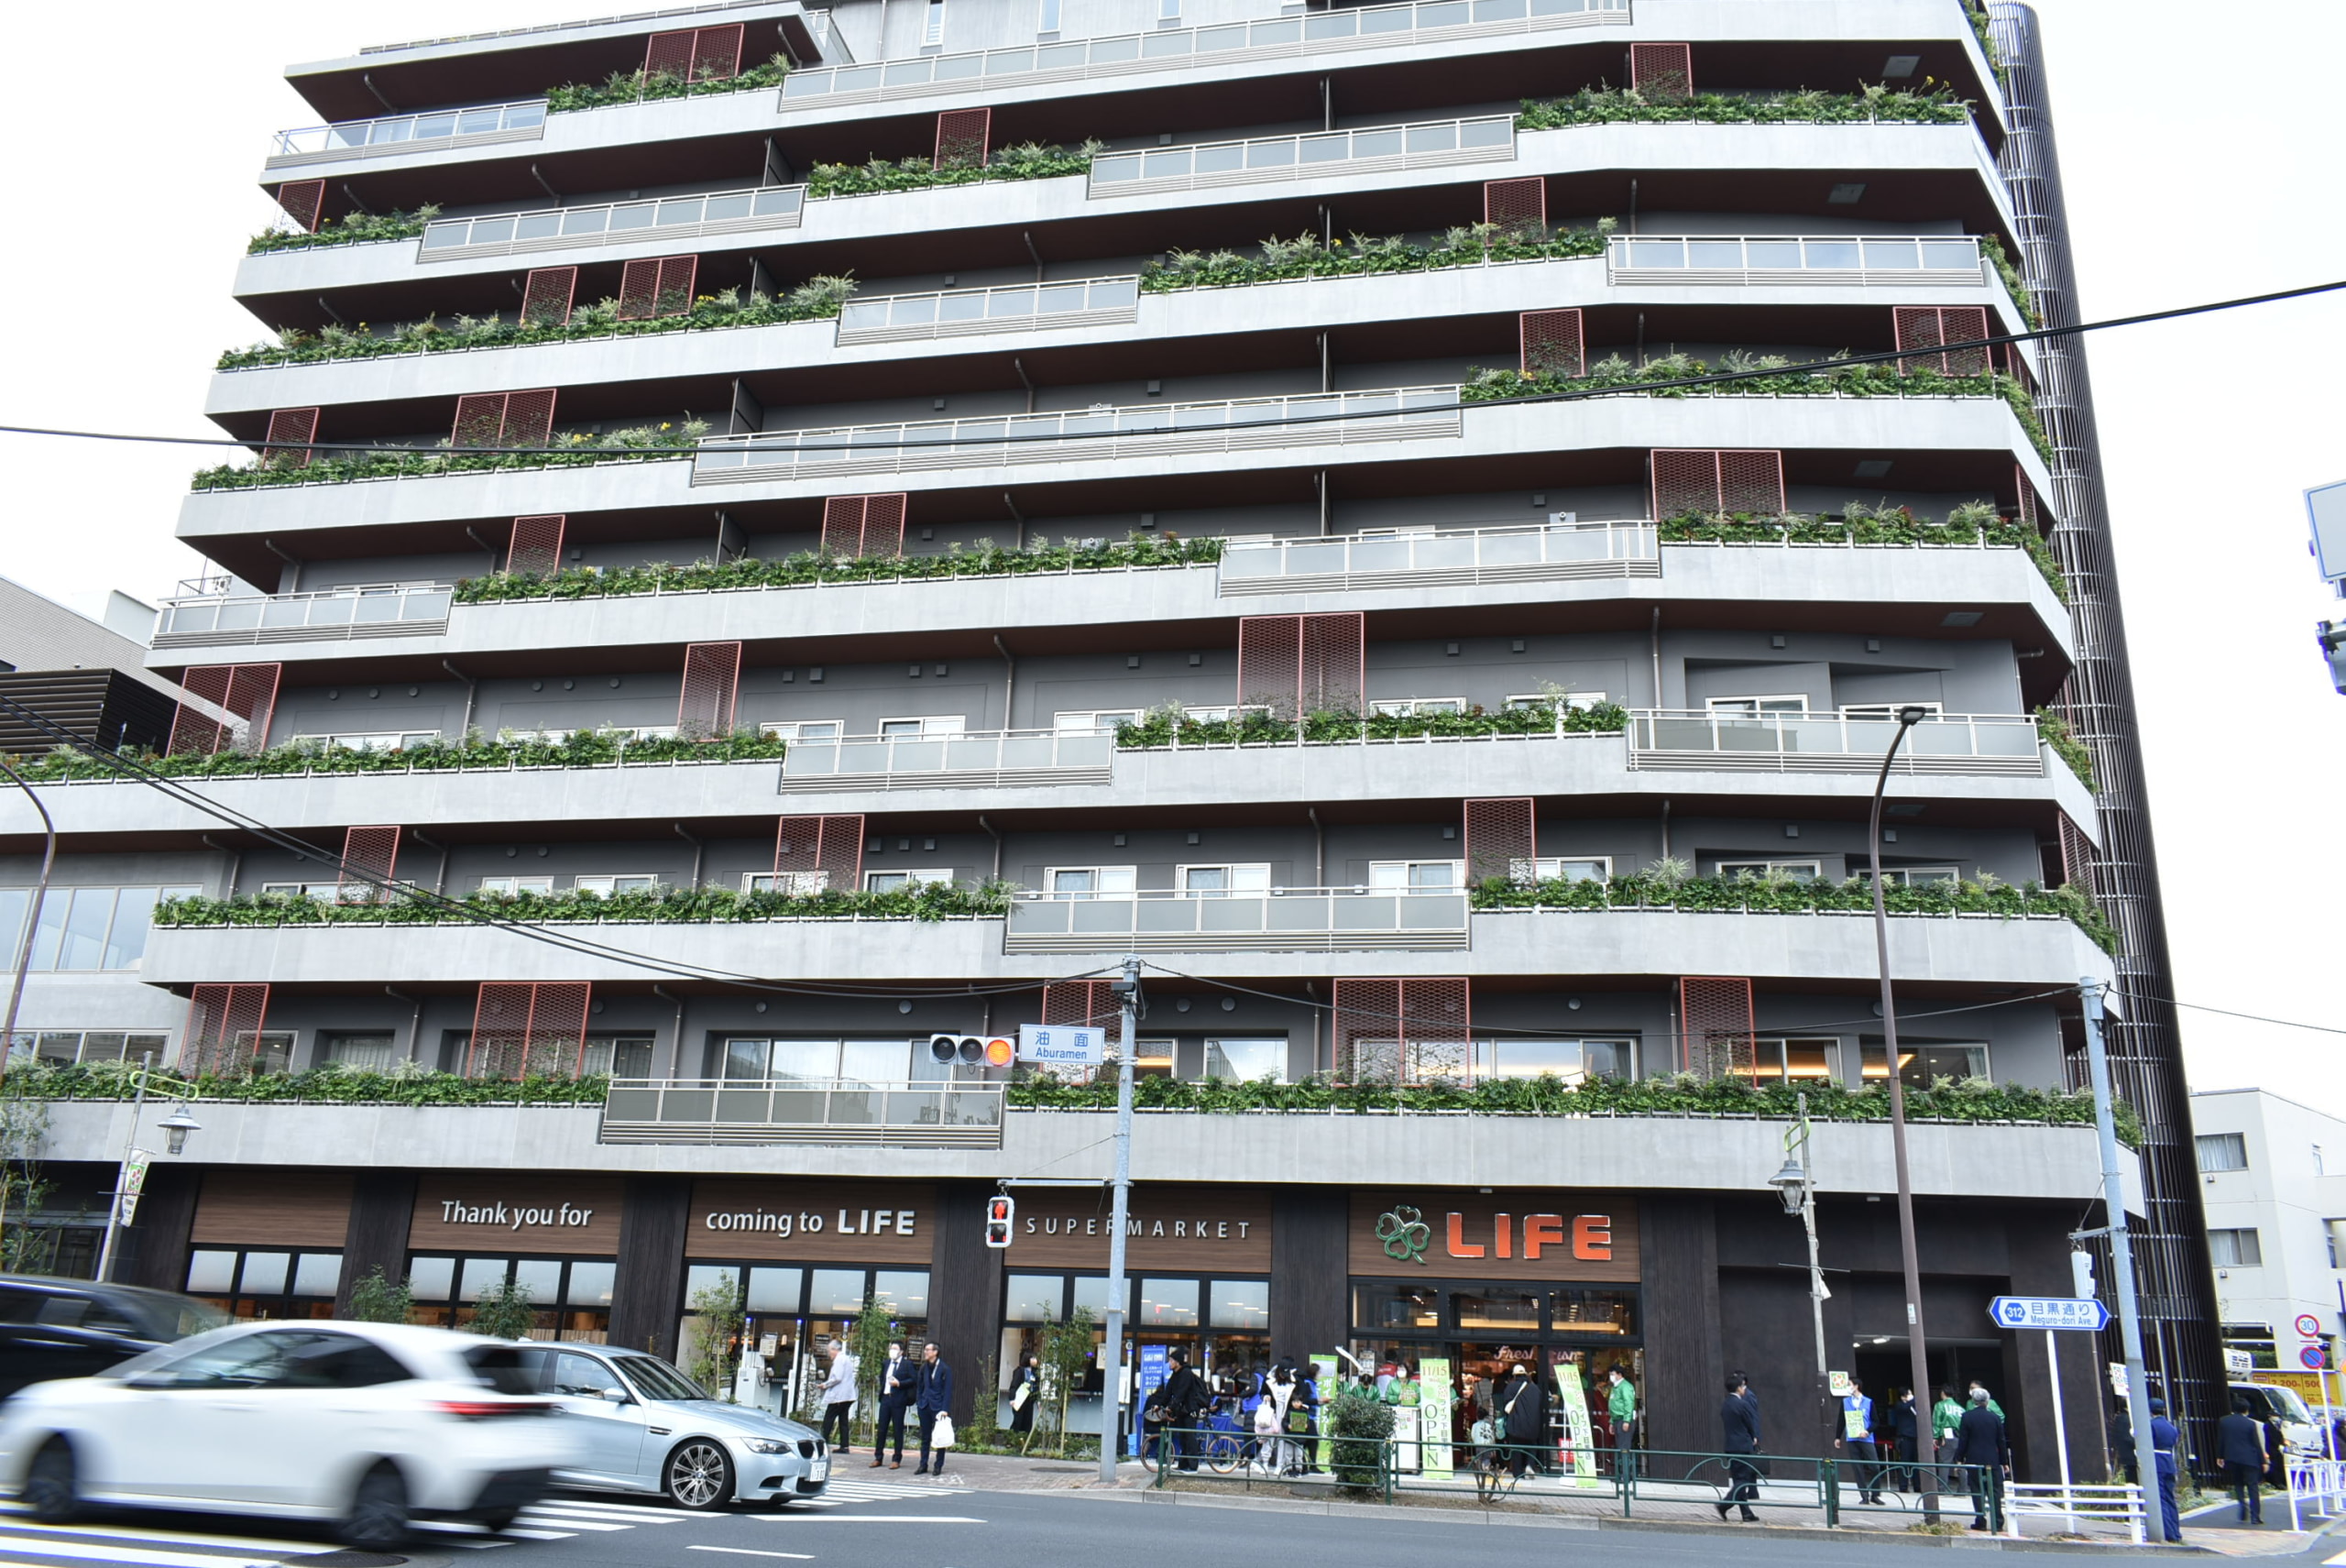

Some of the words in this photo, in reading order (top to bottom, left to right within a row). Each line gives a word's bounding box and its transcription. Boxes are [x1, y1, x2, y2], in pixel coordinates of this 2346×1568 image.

[1036, 1031, 1089, 1047] 油面
[1036, 1047, 1087, 1059] Aburamen
[442, 1201, 508, 1224] Thank
[511, 1208, 554, 1231] you
[559, 1202, 593, 1226] for
[706, 1208, 793, 1238] coming
[799, 1212, 823, 1233] to
[838, 1209, 915, 1235] LIFE
[1446, 1212, 1611, 1260] LIFE
[2006, 1307, 2023, 1318] 312
[2031, 1302, 2090, 1316] 目黒通り
[2031, 1315, 2076, 1325] Meguro-dori
[2300, 1320, 2315, 1331] 30
[1422, 1366, 1447, 1376] 11/15
[1425, 1404, 1438, 1466] OPEN
[1570, 1409, 1586, 1475] OPEN
